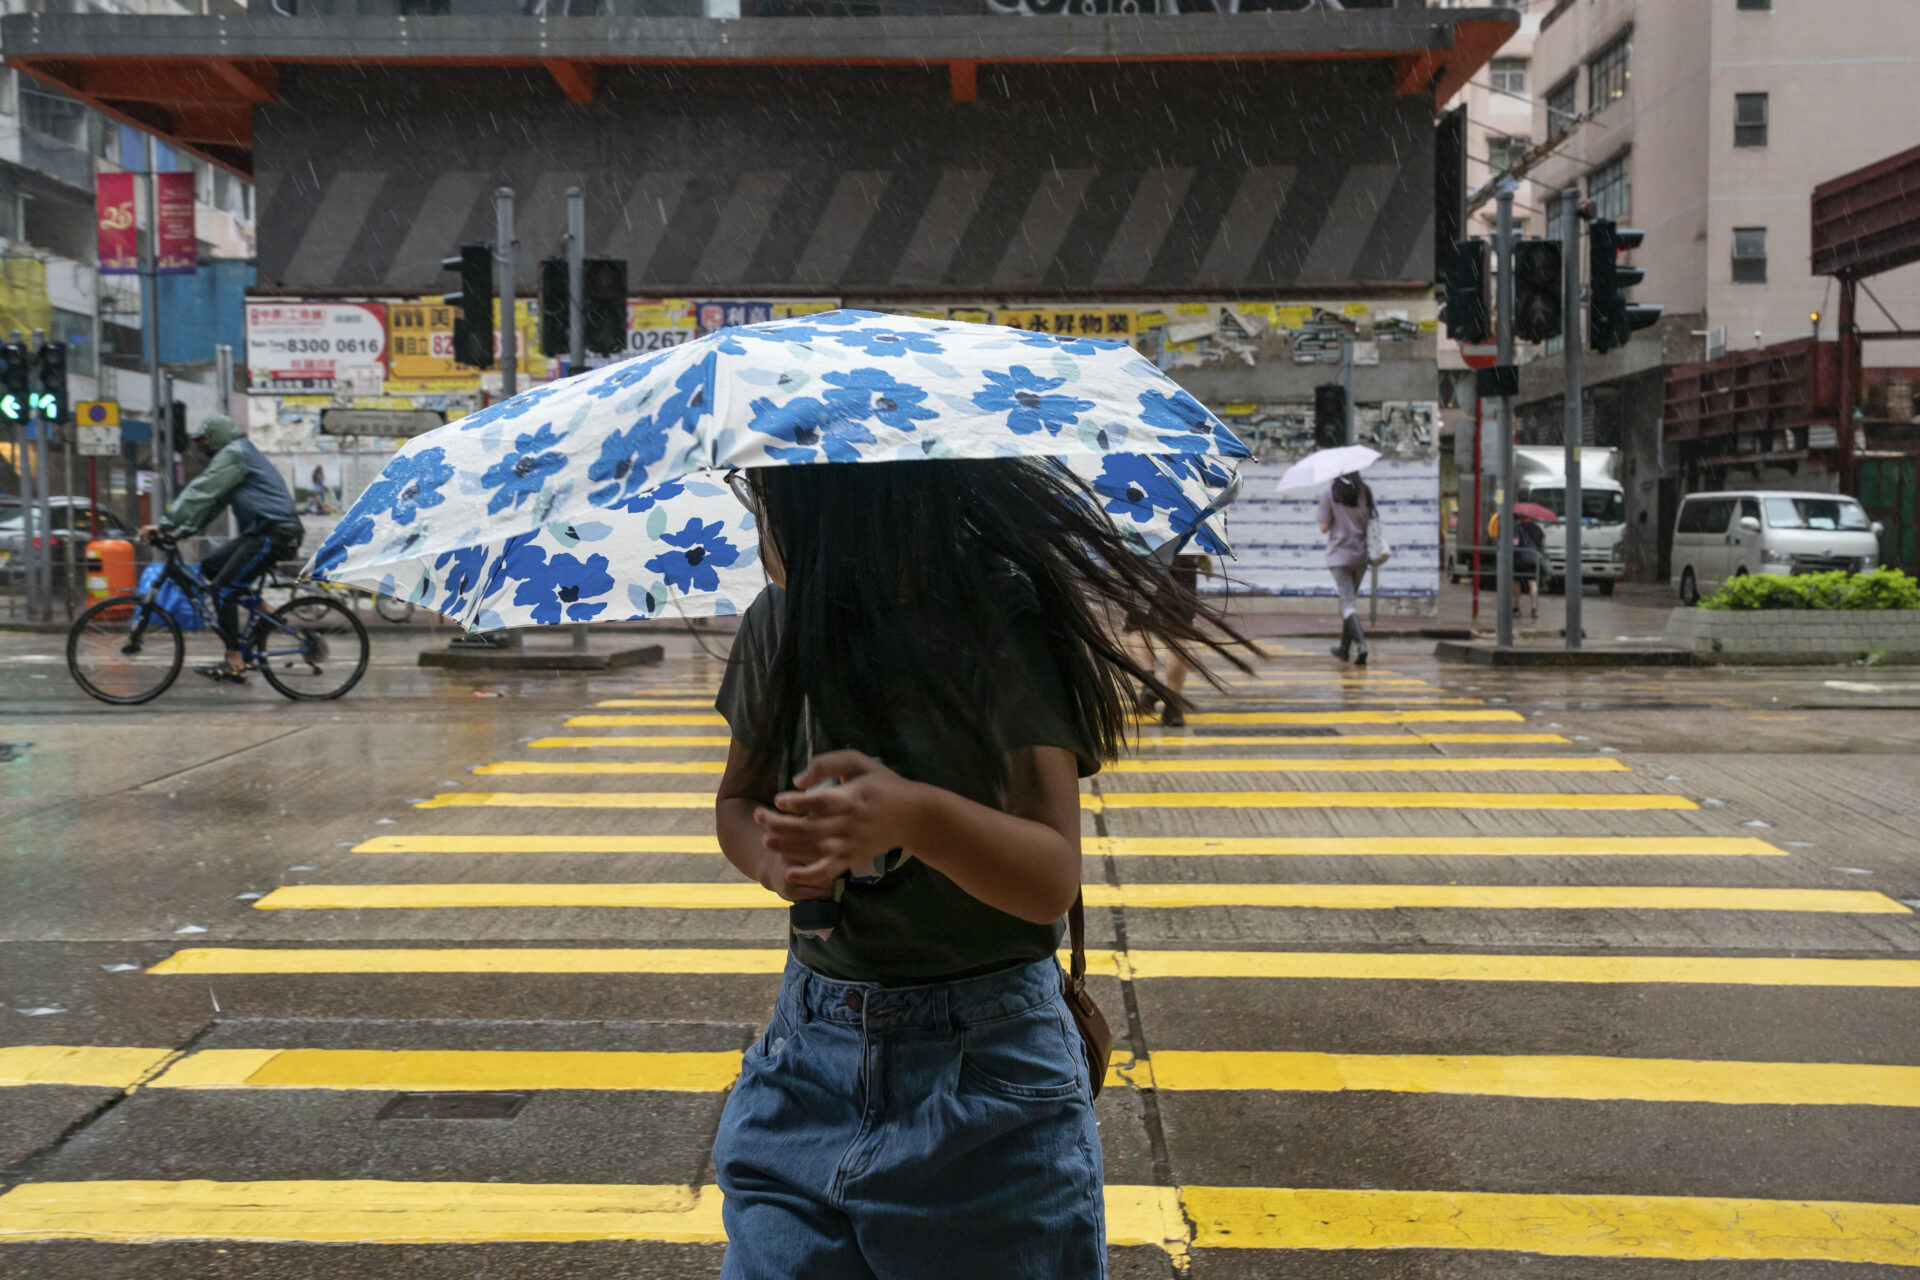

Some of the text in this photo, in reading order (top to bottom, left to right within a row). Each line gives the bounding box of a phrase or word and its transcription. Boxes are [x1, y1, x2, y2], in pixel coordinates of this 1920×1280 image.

[99, 200, 132, 231] 25
[288, 339, 330, 353] 8300
[336, 339, 379, 353] 0616
[631, 331, 688, 349] 0267
